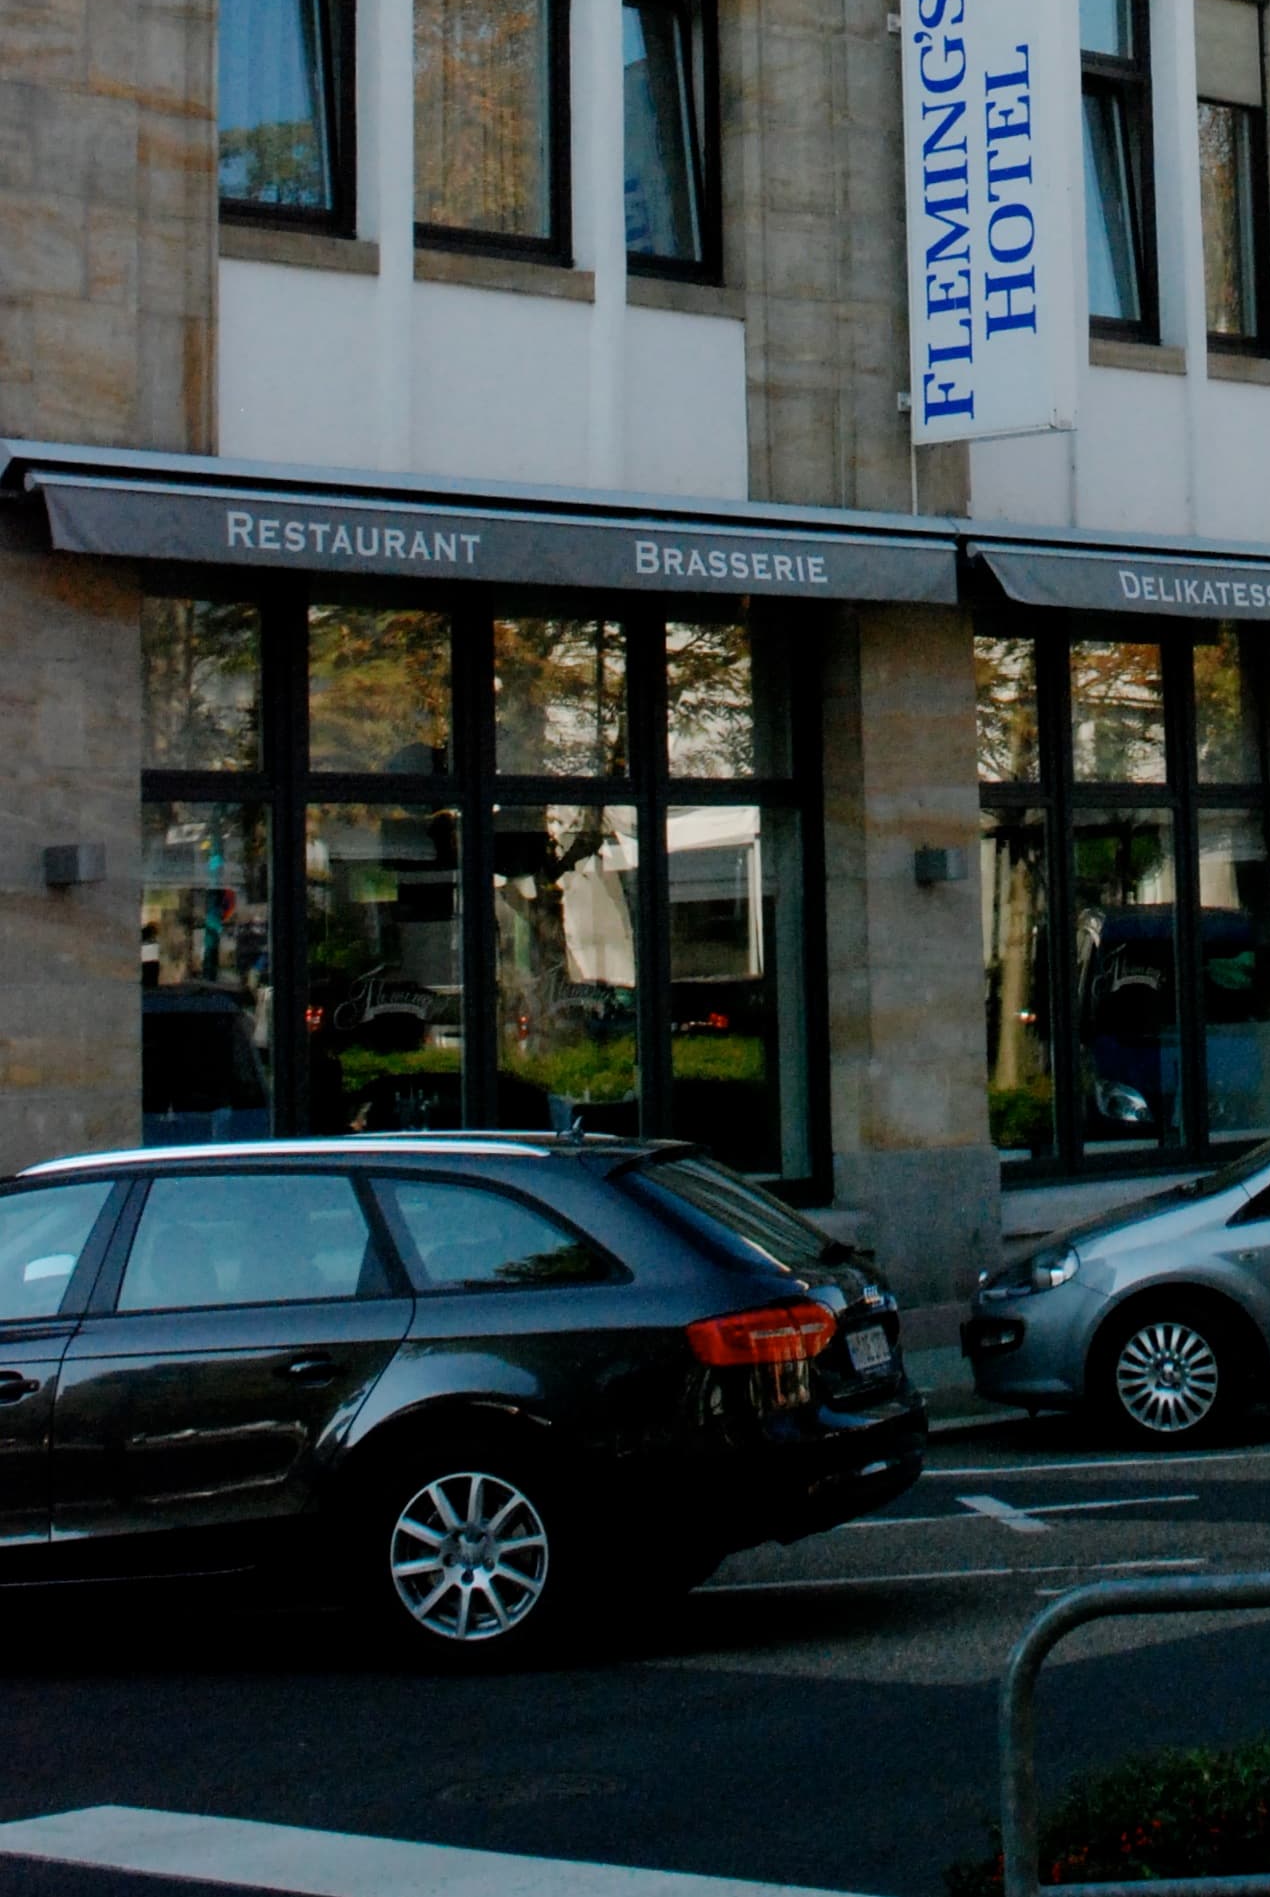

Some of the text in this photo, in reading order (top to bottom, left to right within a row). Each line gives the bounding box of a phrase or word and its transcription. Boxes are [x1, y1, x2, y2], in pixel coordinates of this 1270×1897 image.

[984, 44, 1037, 341] HOTEL
[226, 511, 828, 584] RESTAURANT BRASSERIE
